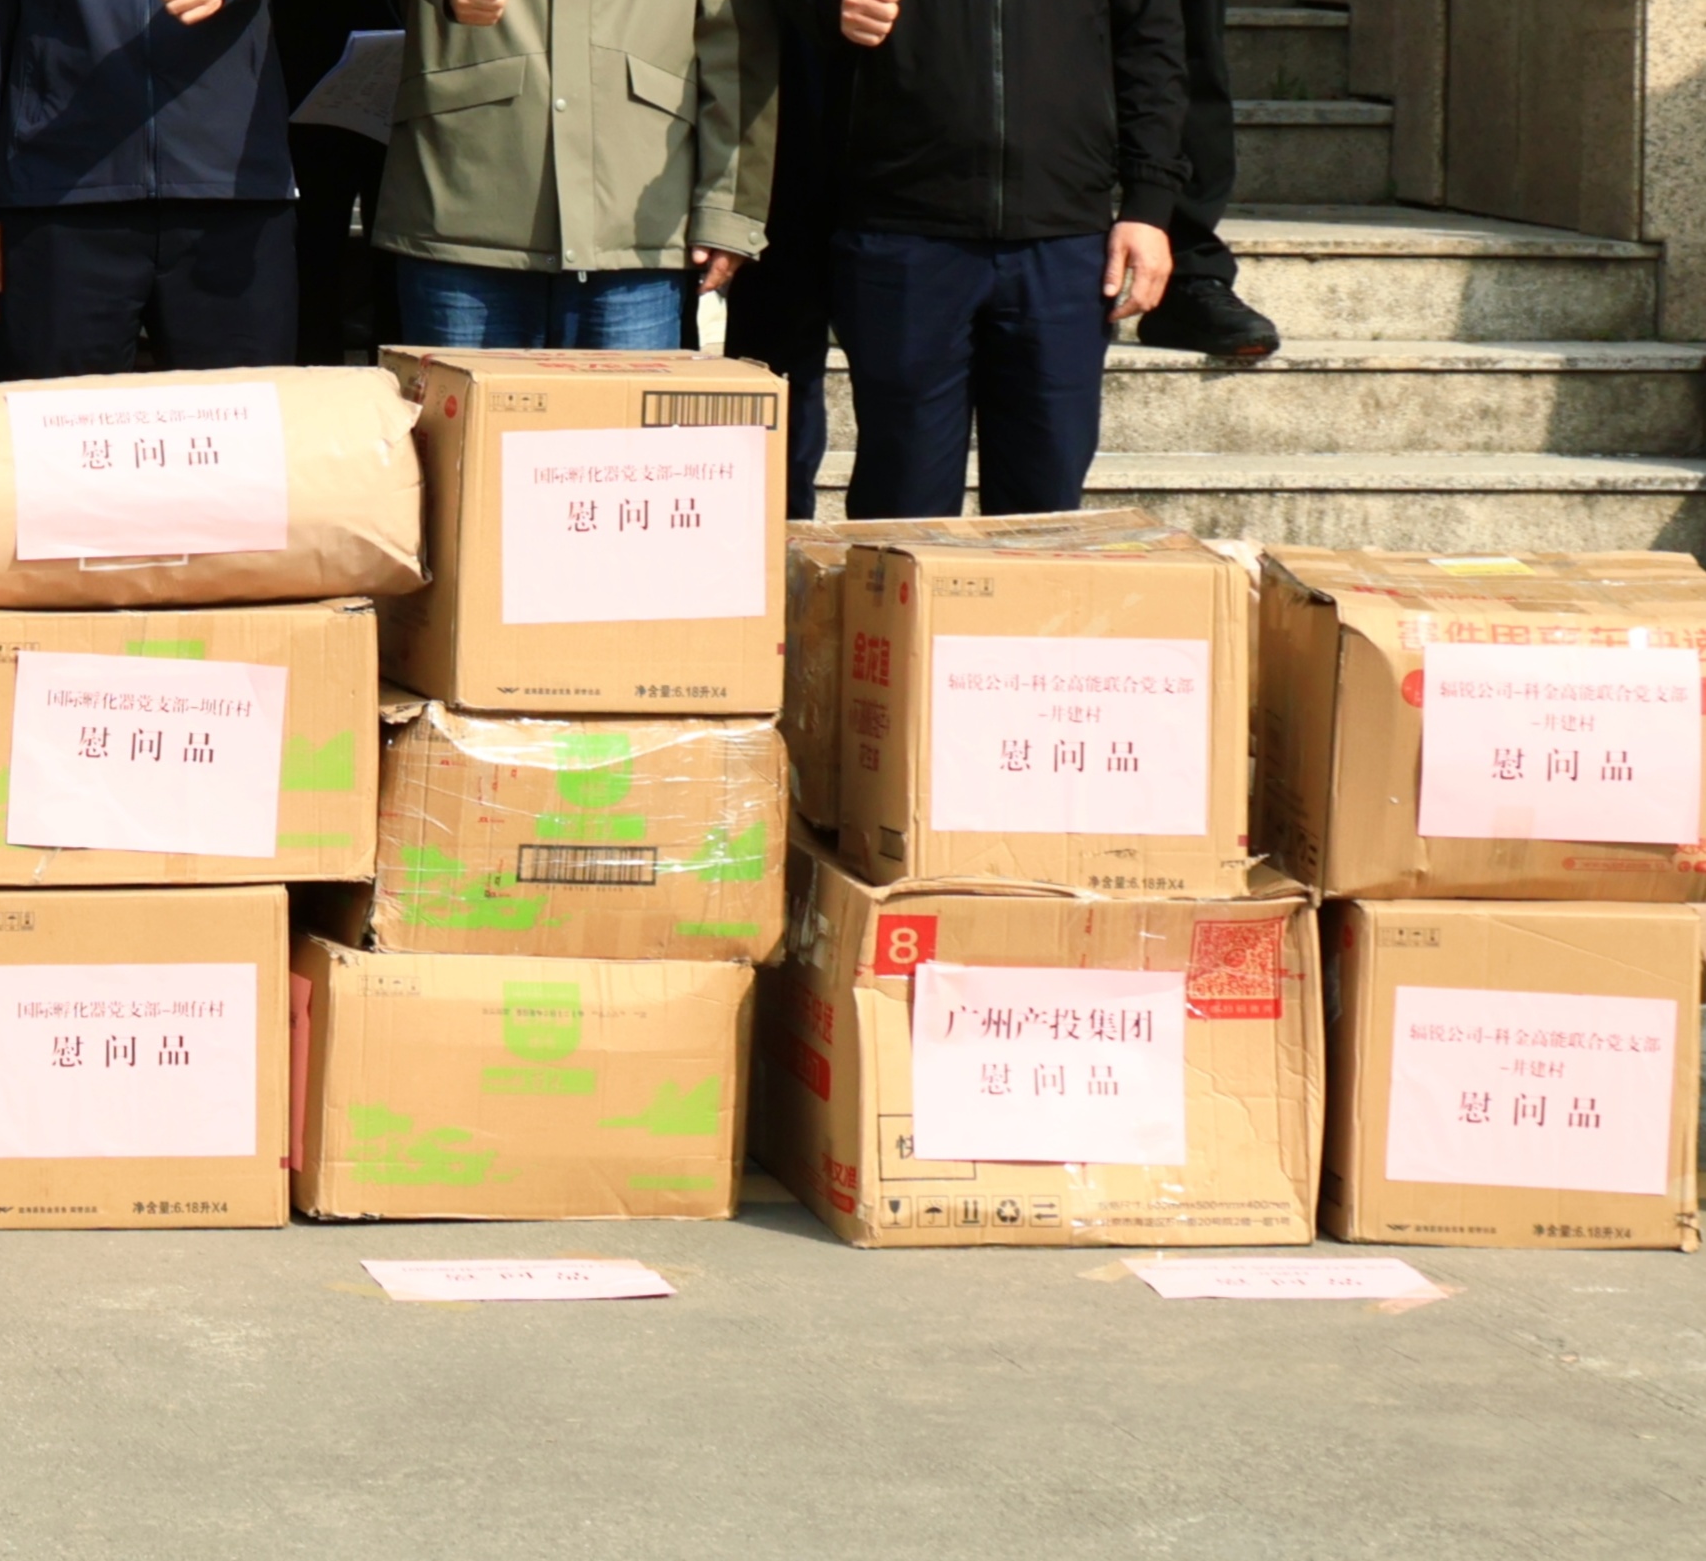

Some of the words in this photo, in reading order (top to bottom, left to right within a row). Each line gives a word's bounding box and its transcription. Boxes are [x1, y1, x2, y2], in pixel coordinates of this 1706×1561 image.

[81, 435, 220, 471] 慰问品
[567, 497, 701, 533] 慰问品
[634, 683, 728, 699] 净含量:6.18升X4
[77, 726, 215, 764] 慰问品
[999, 738, 1139, 774] 慰问品
[1491, 747, 1634, 783] 慰问品
[886, 927, 919, 966] 8
[944, 1004, 1153, 1044] 广州产投集团
[51, 1034, 190, 1069] 慰问品
[980, 1062, 1120, 1098] 慰问品
[1457, 1090, 1602, 1130] 慰问品
[131, 1200, 229, 1216] 净含量:6.18升X4
[1532, 1223, 1633, 1241] 净含量:6.18升X4
